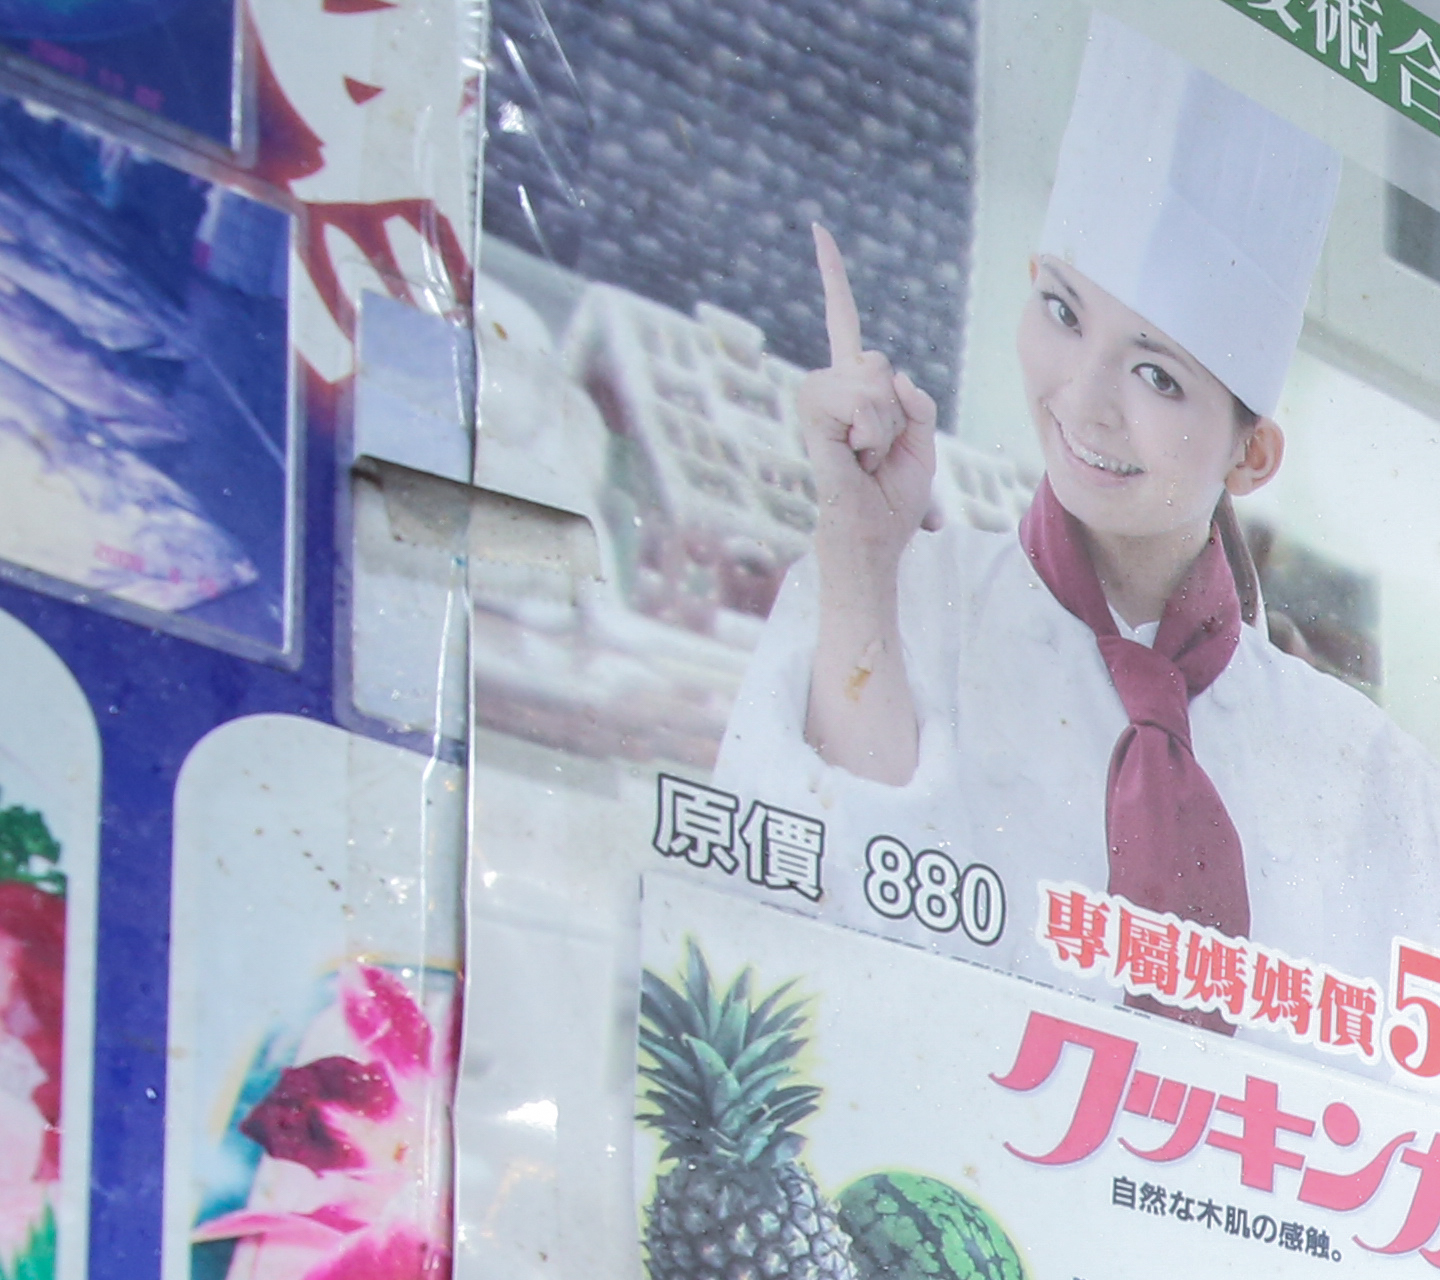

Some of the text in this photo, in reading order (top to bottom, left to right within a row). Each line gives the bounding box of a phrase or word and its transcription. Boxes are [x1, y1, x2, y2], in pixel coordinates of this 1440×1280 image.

[653, 772, 1006, 946] 原價 880
[1044, 889, 1377, 1056] 專屬媽媽價
[1112, 1176, 1342, 1263] 自然な木肌の感触。
